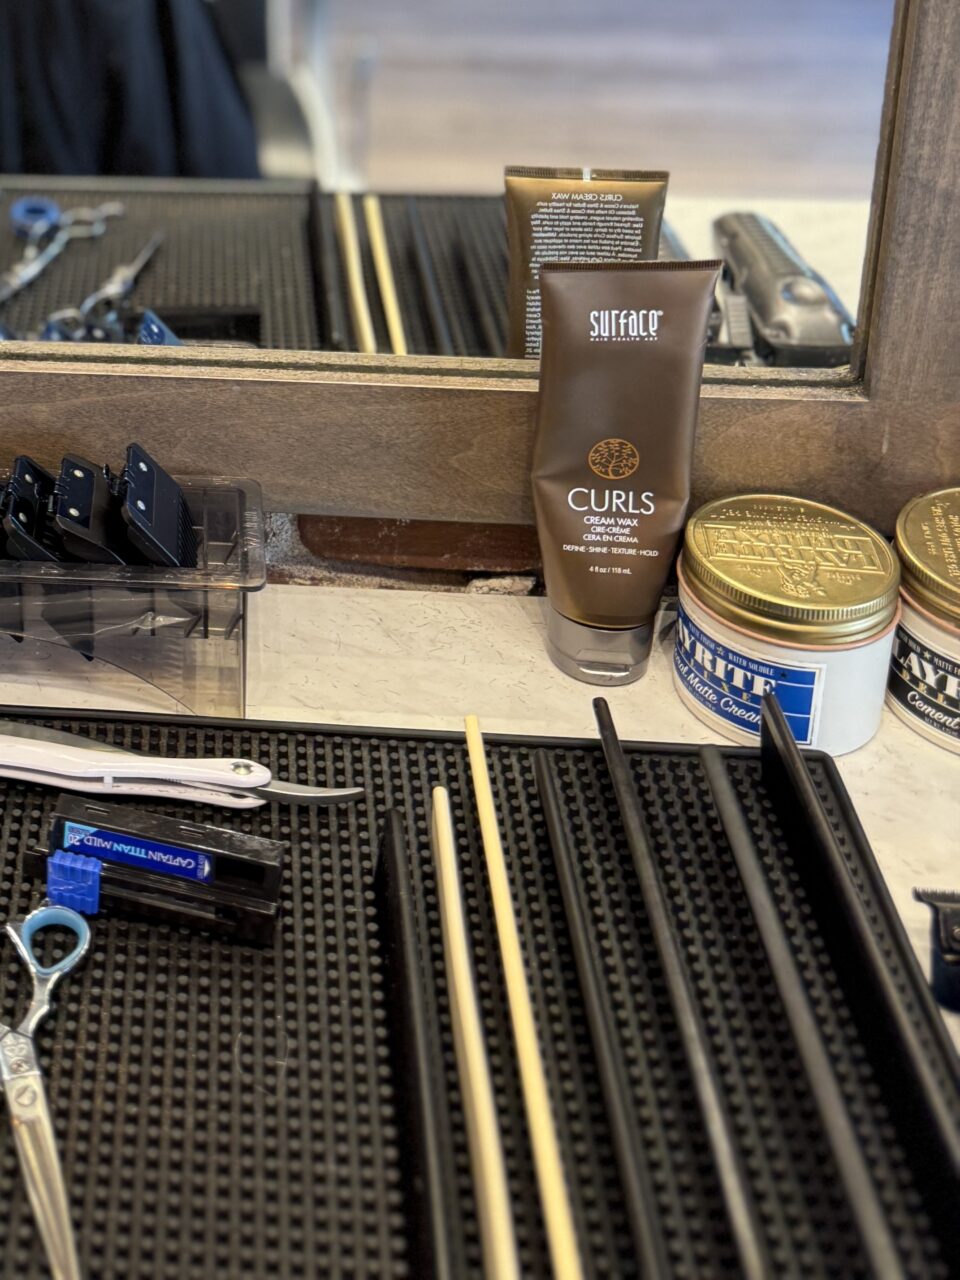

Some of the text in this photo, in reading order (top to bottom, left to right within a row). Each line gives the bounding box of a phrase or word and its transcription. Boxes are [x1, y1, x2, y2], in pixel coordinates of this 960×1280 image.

[568, 487, 655, 515] CURLS
[583, 516, 639, 527] CREAM WAX
[613, 535, 639, 543] CREMA
[687, 673, 718, 704] Matte
[907, 691, 960, 729] Cement
[68, 833, 80, 846] 20
[83, 835, 114, 850] MILD
[113, 842, 147, 858] TITAN
[148, 850, 196, 869] CAPTAIN
